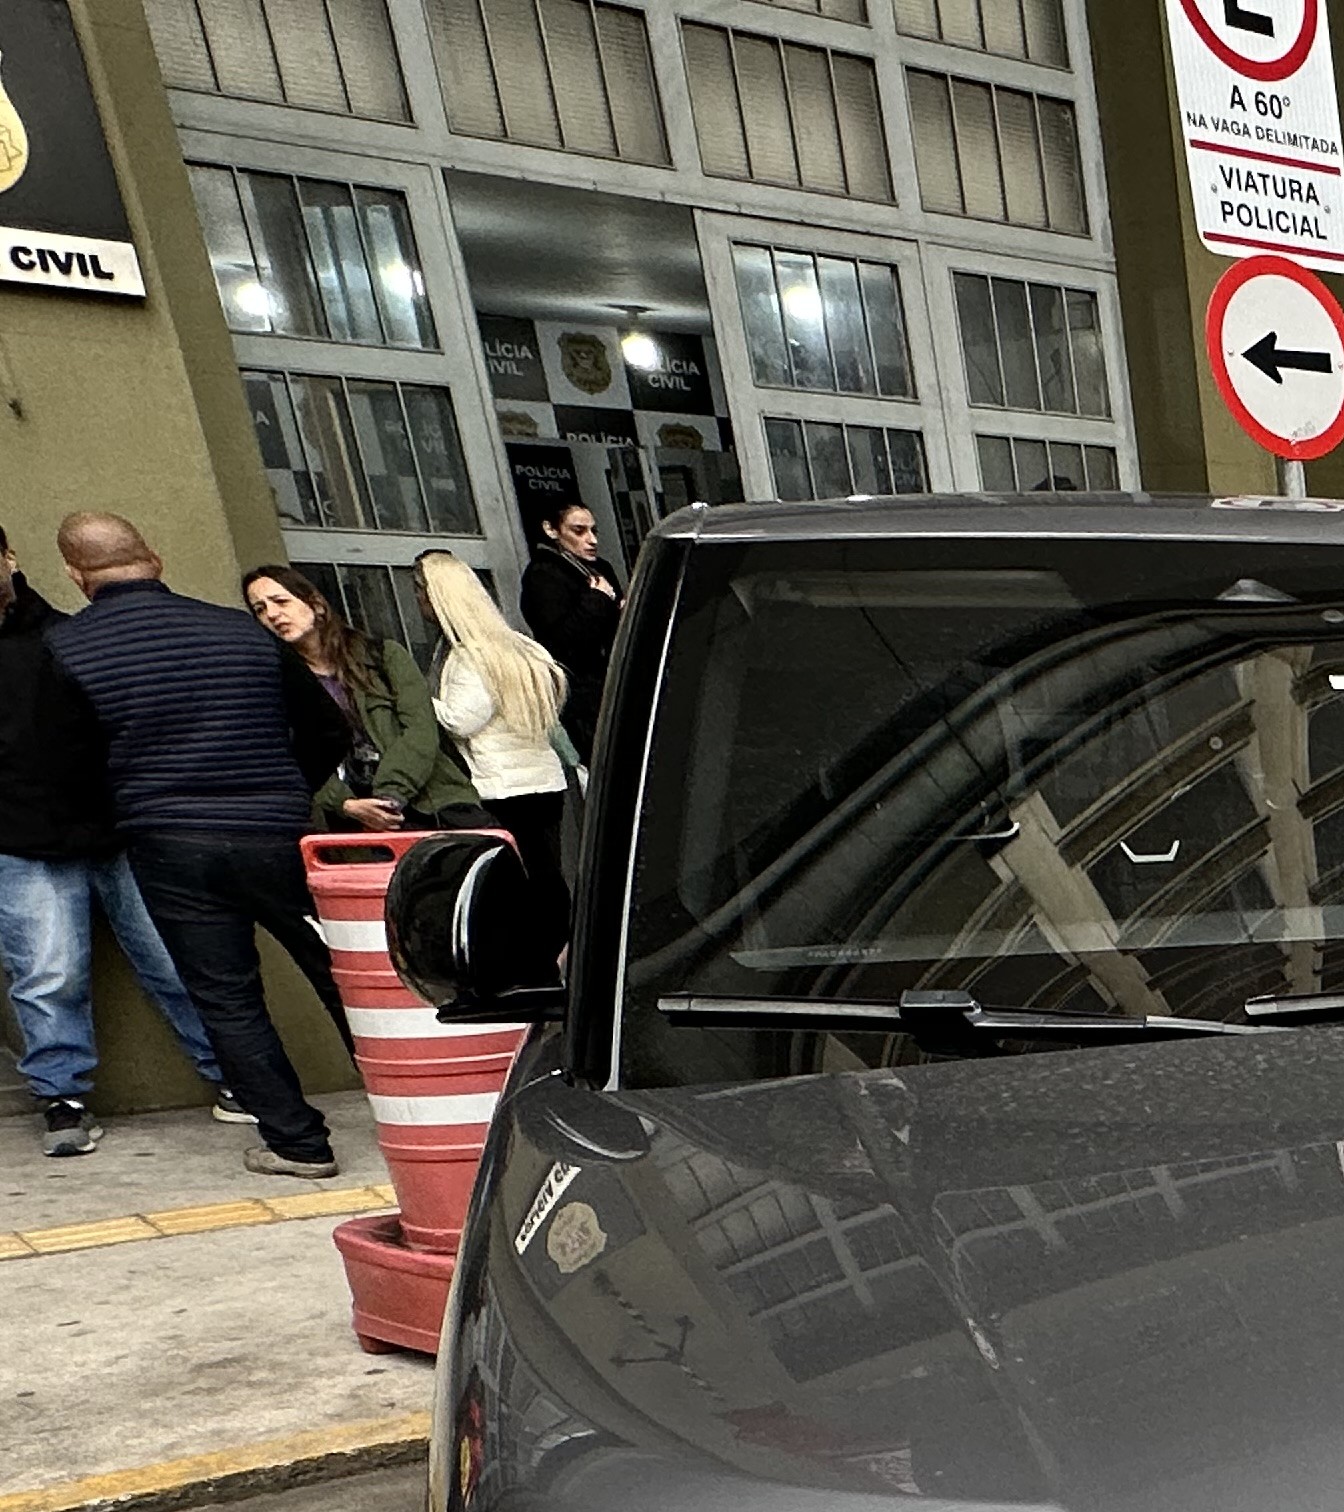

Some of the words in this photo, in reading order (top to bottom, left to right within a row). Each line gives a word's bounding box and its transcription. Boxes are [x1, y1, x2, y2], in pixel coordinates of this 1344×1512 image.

[1230, 84, 1248, 112] A
[1186, 111, 1208, 130] NA
[1211, 116, 1252, 138] VAGA
[1255, 125, 1340, 156] DELIMITADA
[1218, 164, 1321, 206] VIATURA
[1220, 200, 1328, 240] POLICIAL
[10, 245, 115, 280] CIVIL
[488, 359, 523, 377] IVIL
[649, 373, 692, 391] CIVIL
[527, 479, 565, 493] CIVIL
